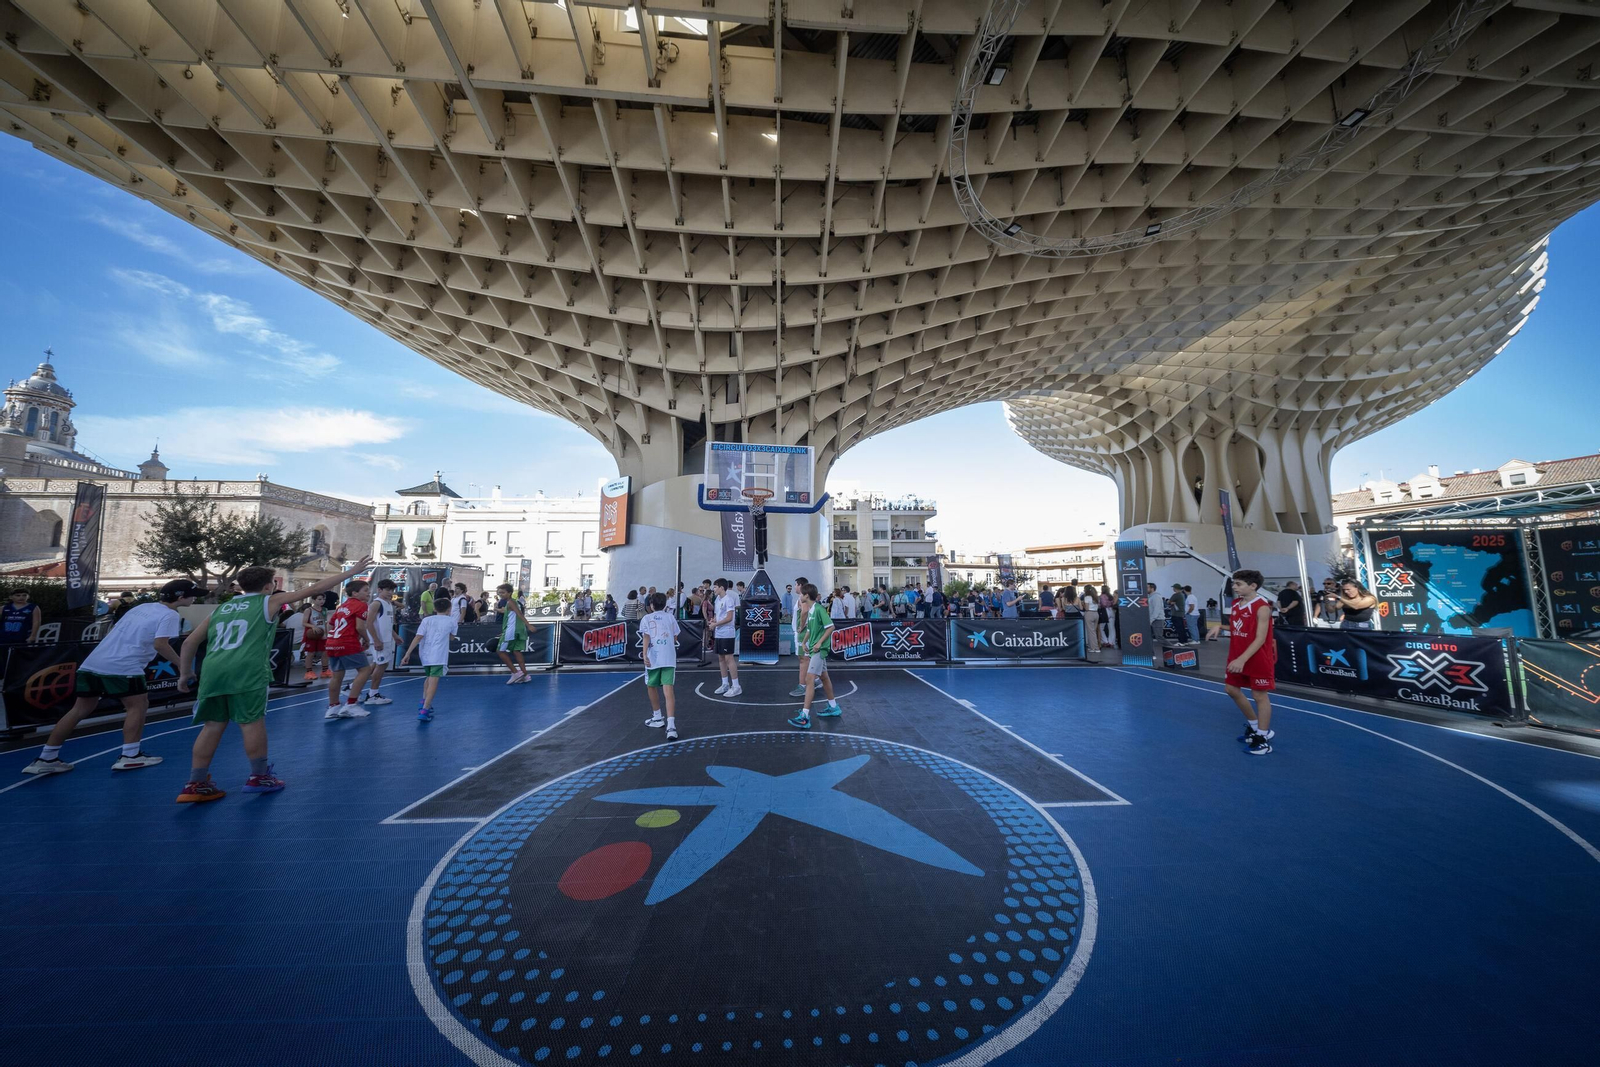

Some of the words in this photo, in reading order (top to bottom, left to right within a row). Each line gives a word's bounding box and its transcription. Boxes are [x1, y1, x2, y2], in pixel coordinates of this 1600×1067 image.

[1472, 535, 1505, 546] 2025
[220, 601, 250, 614] CNS
[211, 619, 249, 652] 10
[584, 623, 625, 652] CANCHA
[831, 623, 871, 652] CANCHA
[991, 630, 1069, 648] CaixaBank
[1405, 641, 1458, 652] CIRCUITO
[884, 651, 922, 660] CaixaBank
[1319, 666, 1358, 679] CaixaBank
[1398, 687, 1482, 712] CaixaBank
